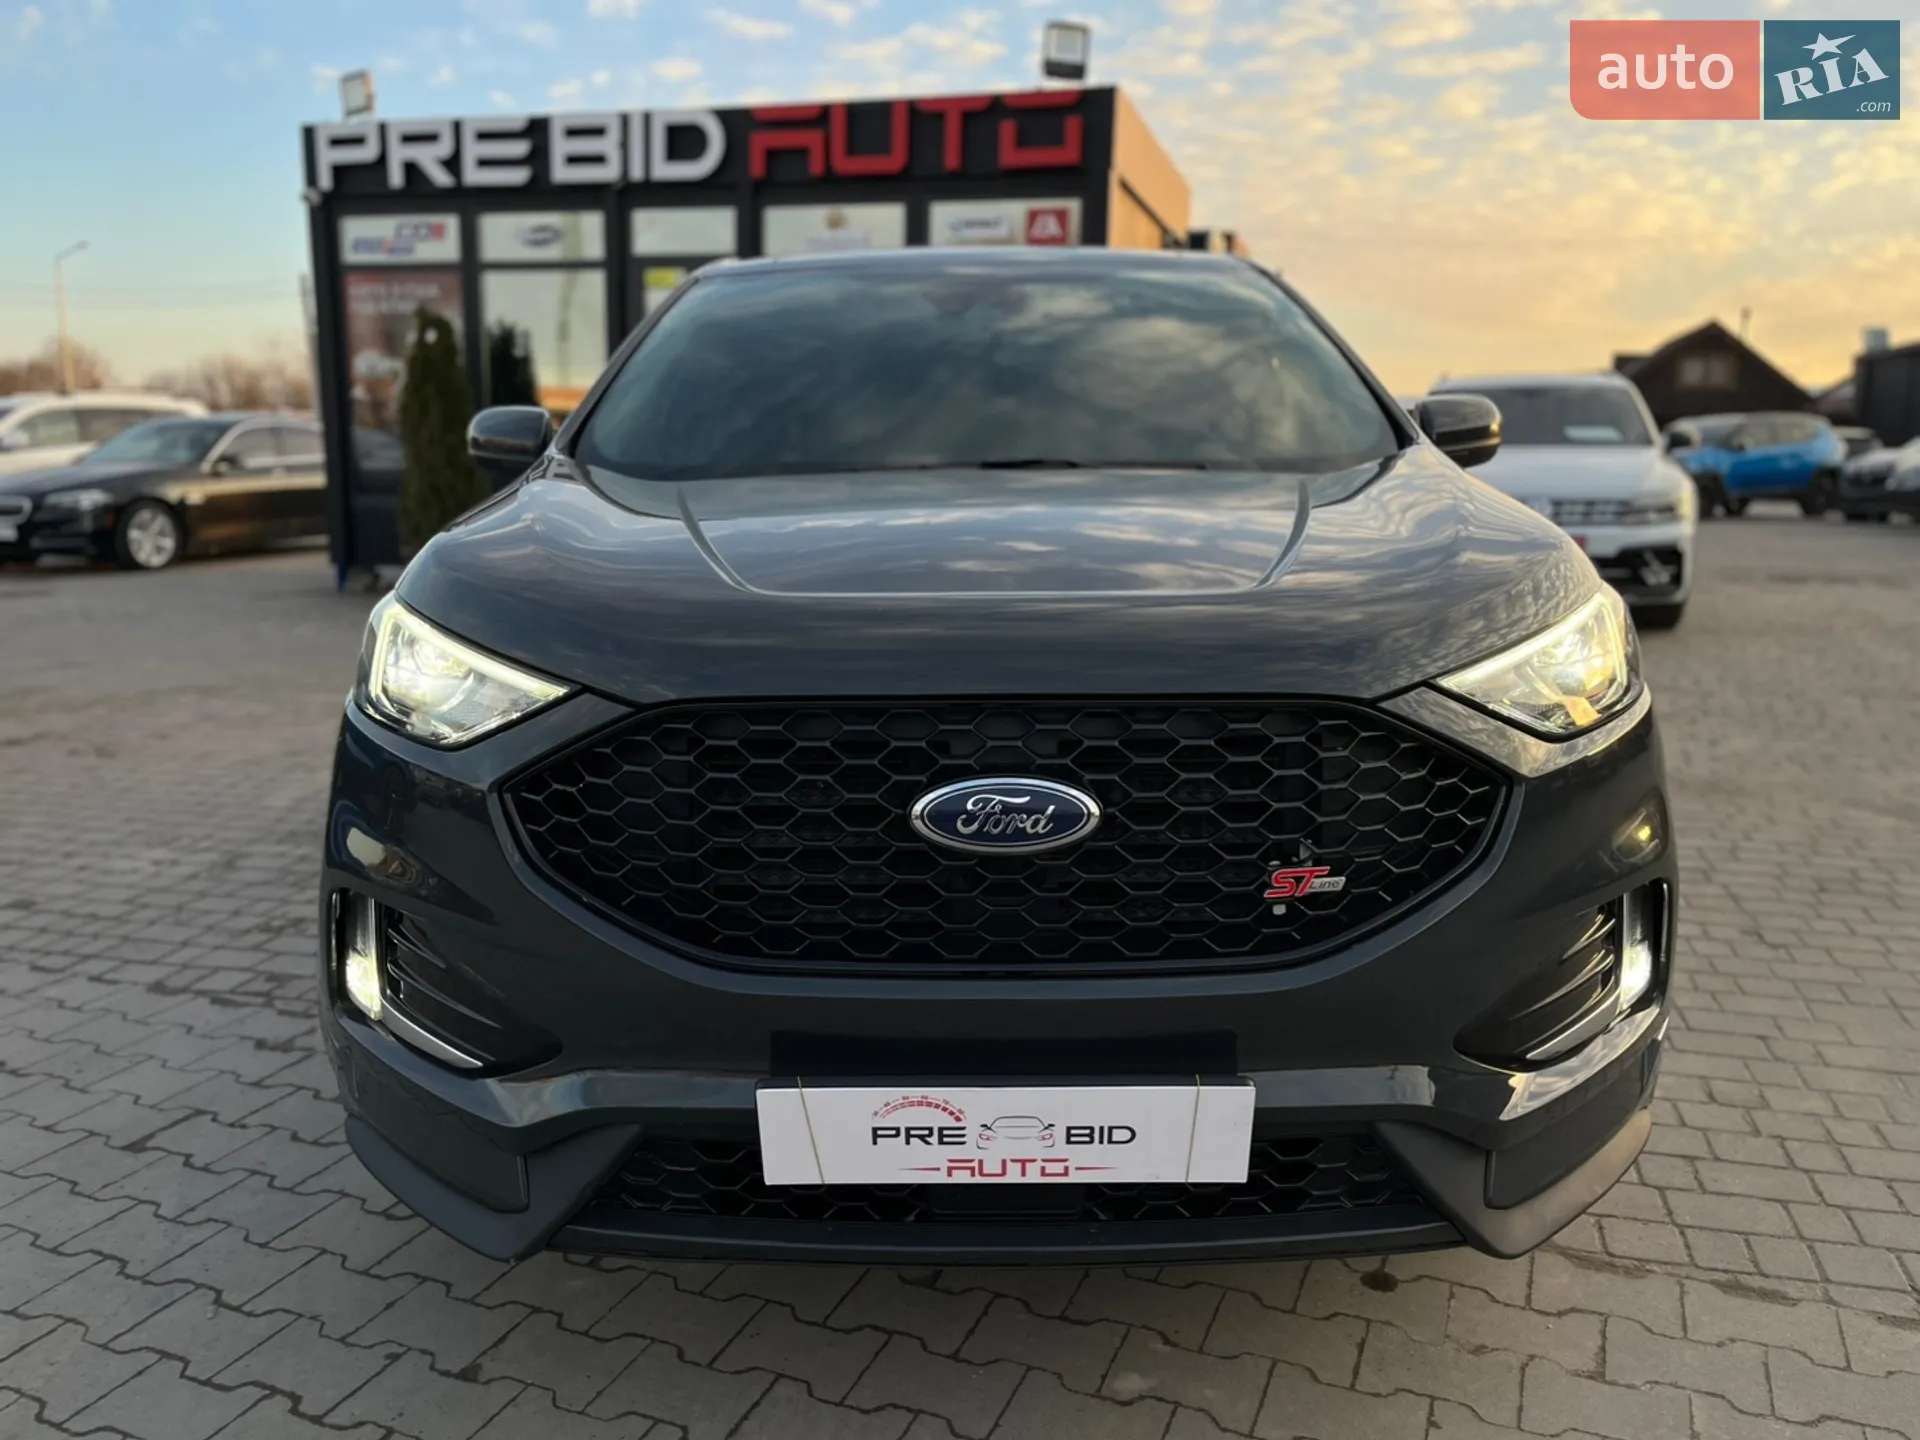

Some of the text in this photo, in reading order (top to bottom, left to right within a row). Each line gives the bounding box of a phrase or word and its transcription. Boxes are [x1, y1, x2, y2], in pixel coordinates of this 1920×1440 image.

[313, 90, 1084, 191] PRE BID AUTO
[955, 793, 1056, 836] Ford
[1263, 866, 1331, 898] ST
[871, 1125, 1137, 1146] PRE BID
[947, 1158, 1070, 1178] AUTO
